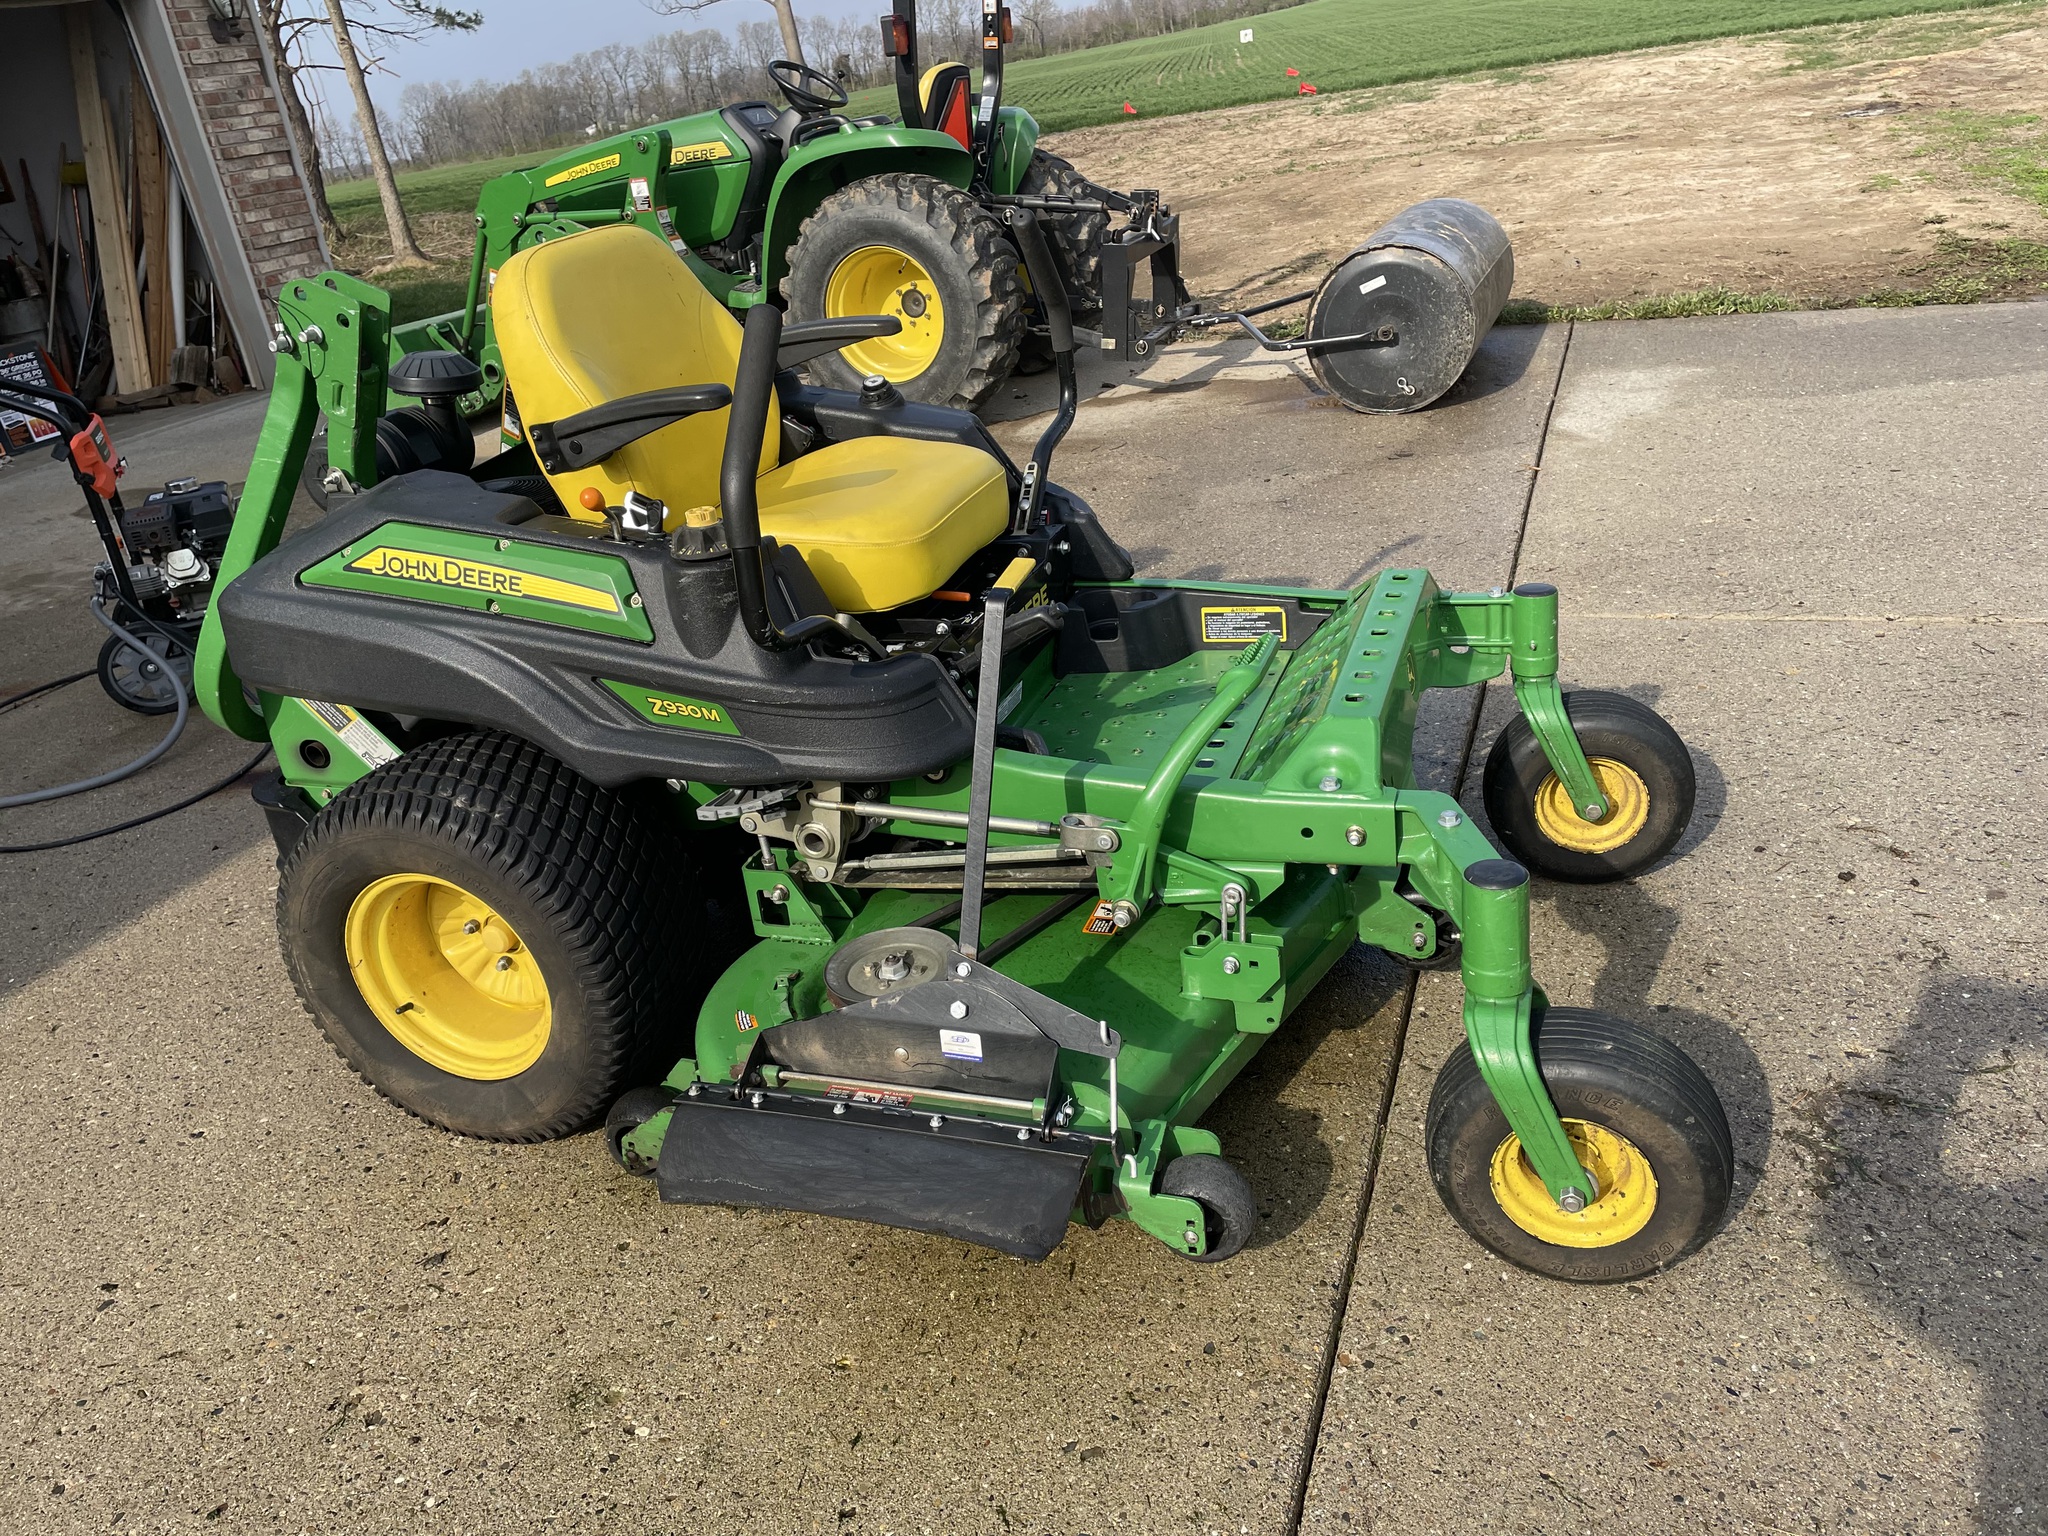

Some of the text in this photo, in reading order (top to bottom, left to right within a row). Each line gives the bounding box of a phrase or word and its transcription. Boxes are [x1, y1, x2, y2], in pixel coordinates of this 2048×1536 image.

[675, 147, 717, 162] DEERE
[566, 156, 618, 180] JOHN DEERE
[0, 352, 36, 366] CKSTONE
[11, 360, 38, 372] GRIDDLE
[374, 552, 523, 594] JOHN DEERE
[645, 696, 721, 722] Z930M
[1550, 1241, 1675, 1279] CARLISLE
